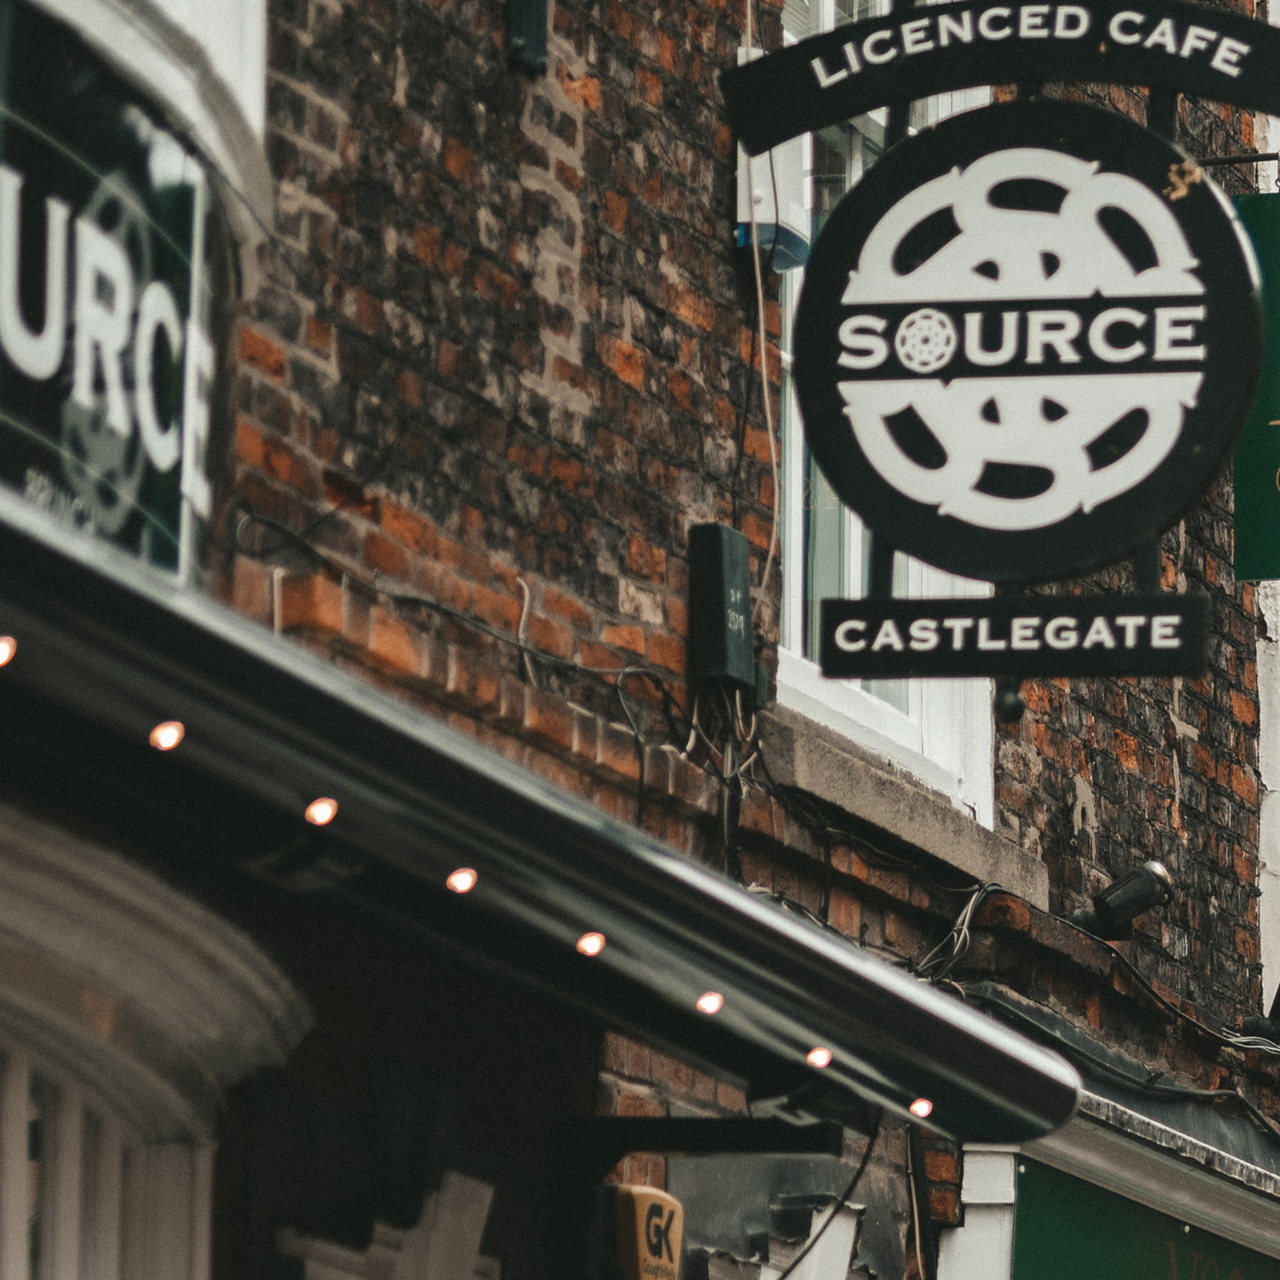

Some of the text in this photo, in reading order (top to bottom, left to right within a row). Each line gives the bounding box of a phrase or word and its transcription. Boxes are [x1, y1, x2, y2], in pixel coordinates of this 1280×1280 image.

[811, 7, 1251, 89] LICENCED CAFE
[837, 303, 1208, 375] SOURCE
[833, 615, 1182, 653] CASTLEGATE
[645, 1203, 675, 1264] GK
